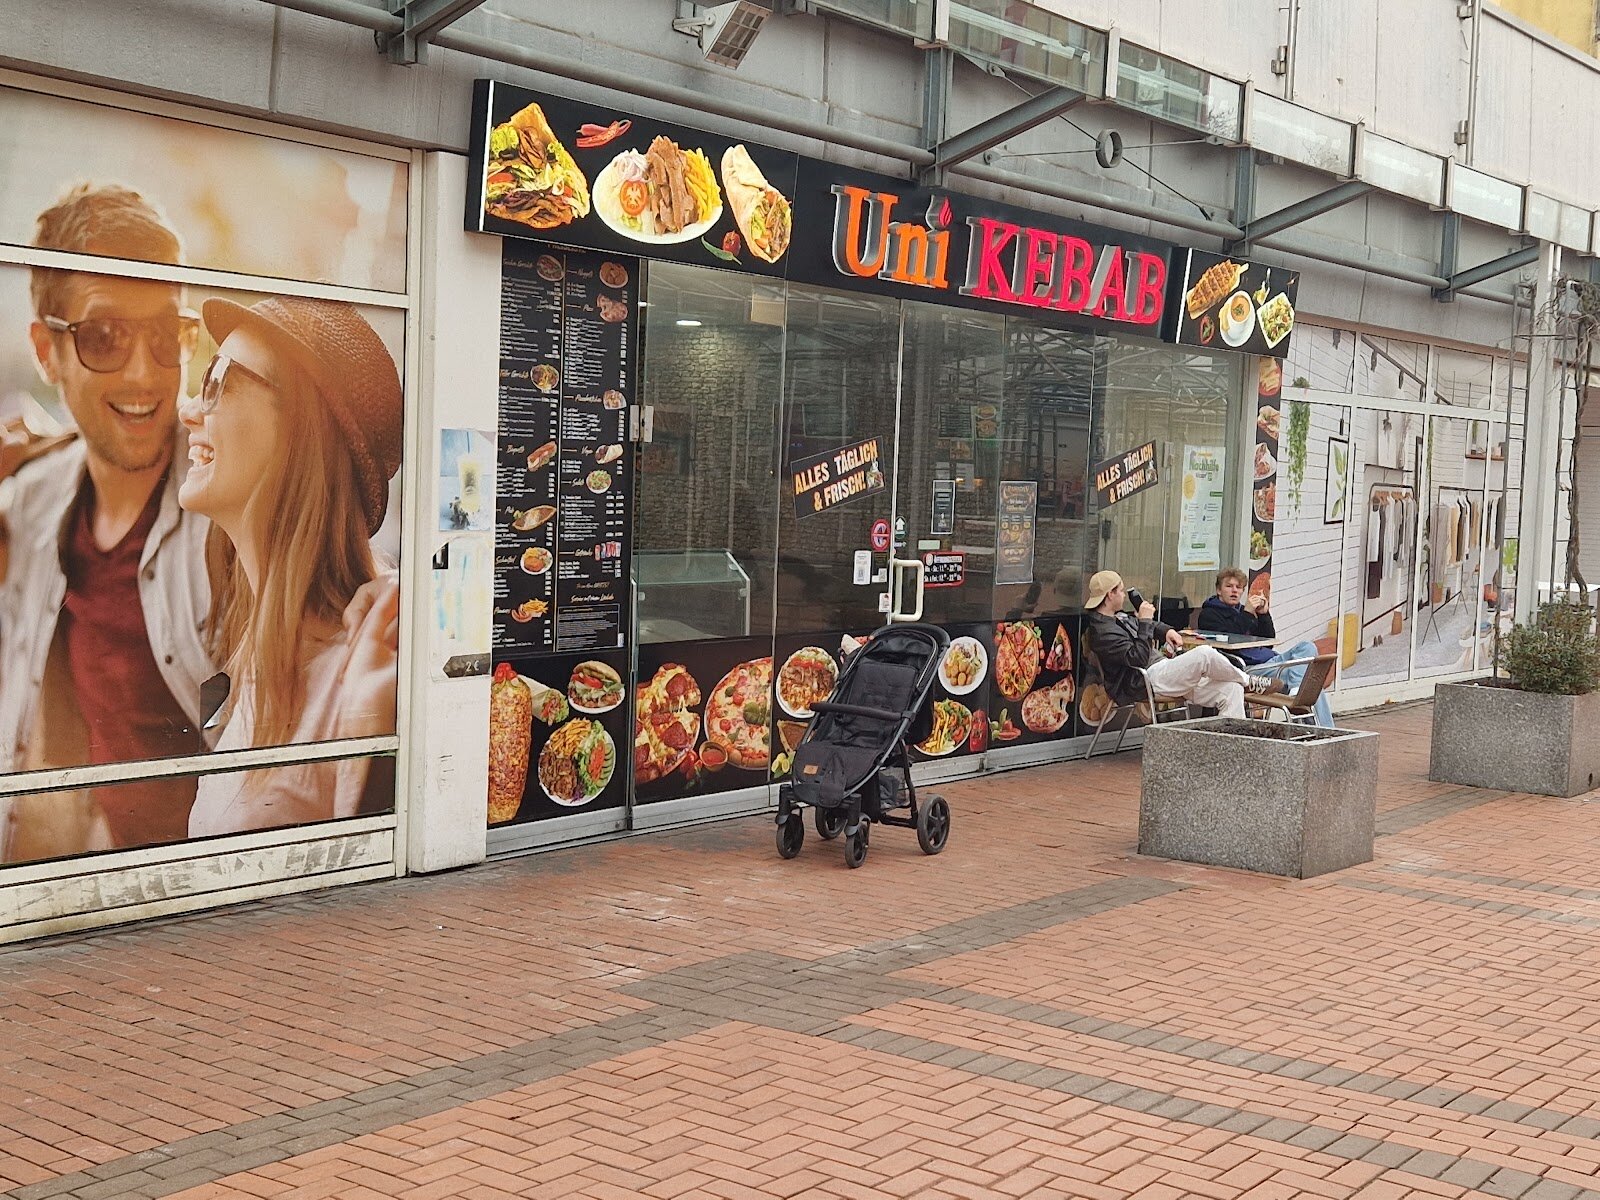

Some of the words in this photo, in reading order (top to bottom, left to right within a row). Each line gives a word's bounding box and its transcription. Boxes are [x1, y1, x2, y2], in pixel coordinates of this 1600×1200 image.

[832, 185, 952, 290] Uni
[959, 216, 1166, 325] KEBAB
[795, 461, 830, 495] ALLES
[833, 439, 878, 476] TÄGLICH
[814, 491, 823, 512] &
[824, 470, 867, 507] FRISCH!
[1097, 463, 1121, 492] ALLES
[1123, 443, 1153, 474] TÄGLICH
[1109, 487, 1117, 504] &
[1116, 468, 1146, 501] FRISCH!
